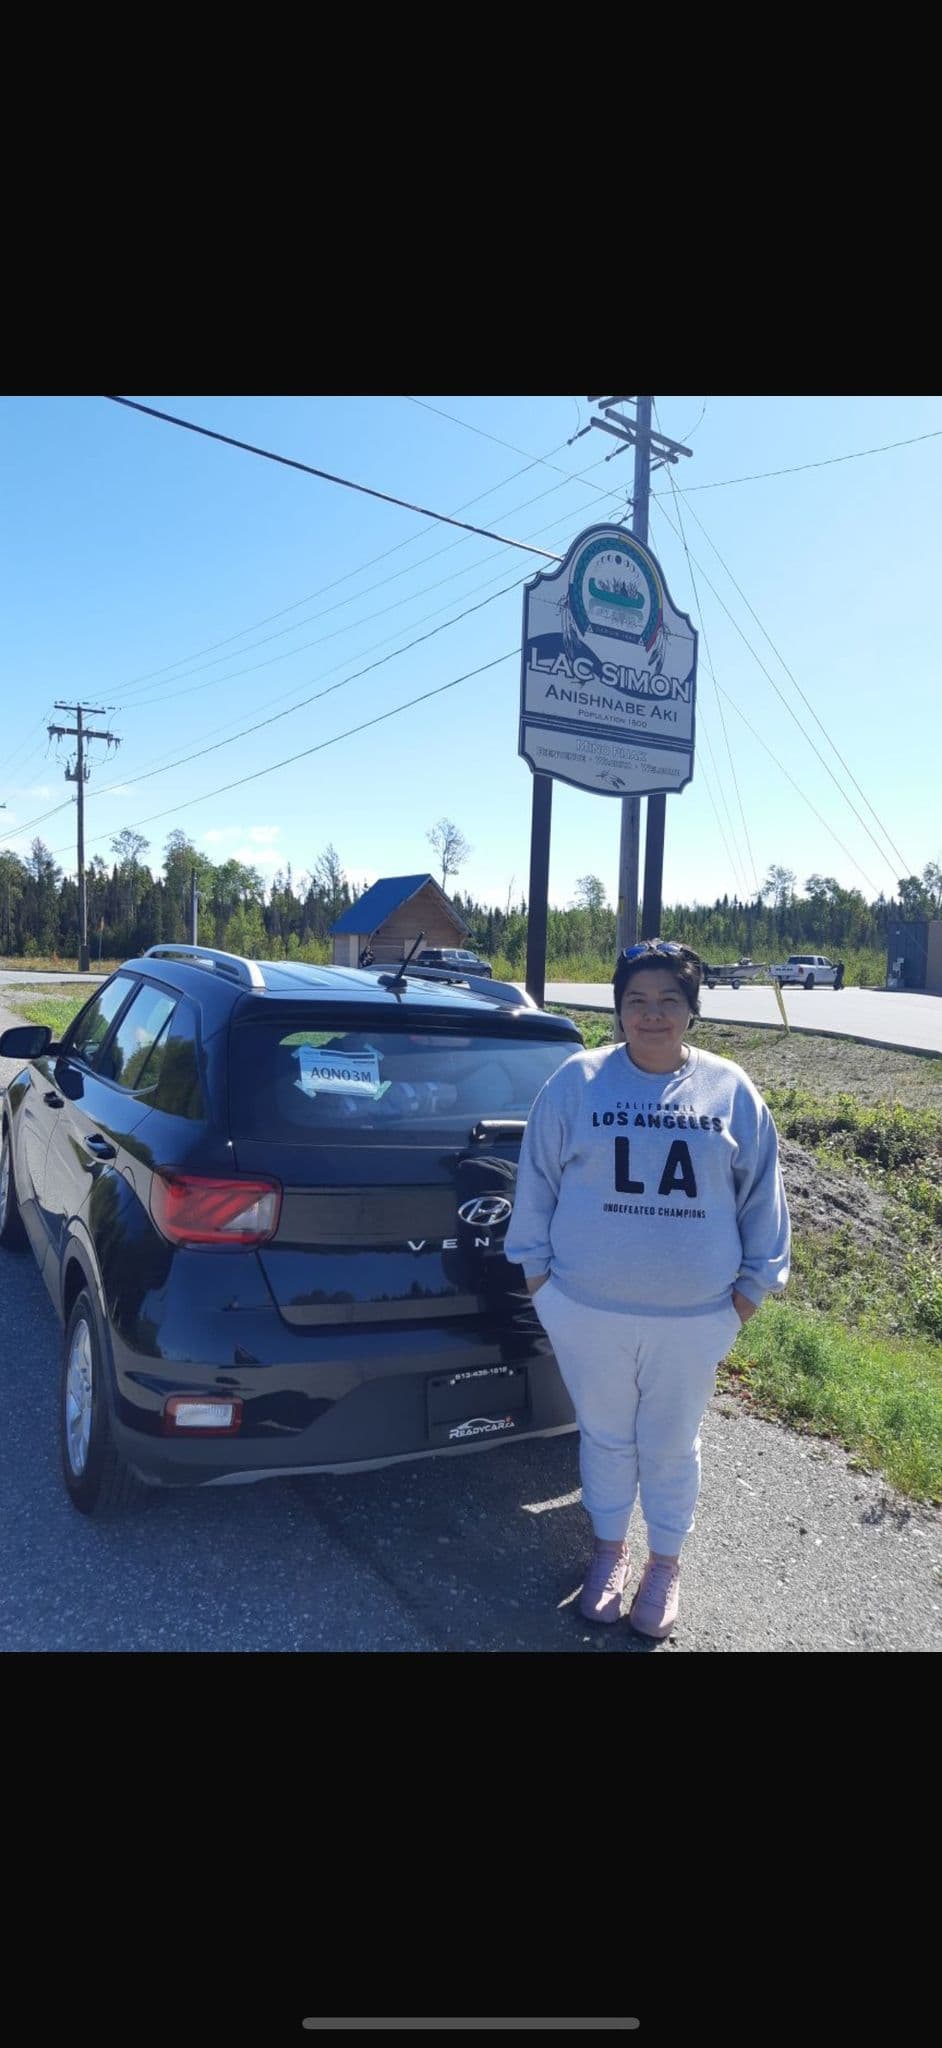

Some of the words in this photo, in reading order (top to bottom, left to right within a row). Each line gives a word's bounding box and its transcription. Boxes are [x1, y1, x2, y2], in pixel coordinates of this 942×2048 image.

[529, 647, 595, 682] LAC
[601, 661, 694, 704] SIMON
[545, 684, 647, 716] ANISHNABE
[651, 705, 678, 723] AKI
[616, 1101, 696, 1113] CALIFORNIA
[592, 1111, 629, 1127] LOS
[634, 1113, 723, 1132] ANGELES
[615, 1136, 698, 1198] LA
[603, 1203, 656, 1216] UNDEFEATED
[658, 1207, 706, 1219] CHAMPIONS
[408, 1237, 490, 1251] VEN
